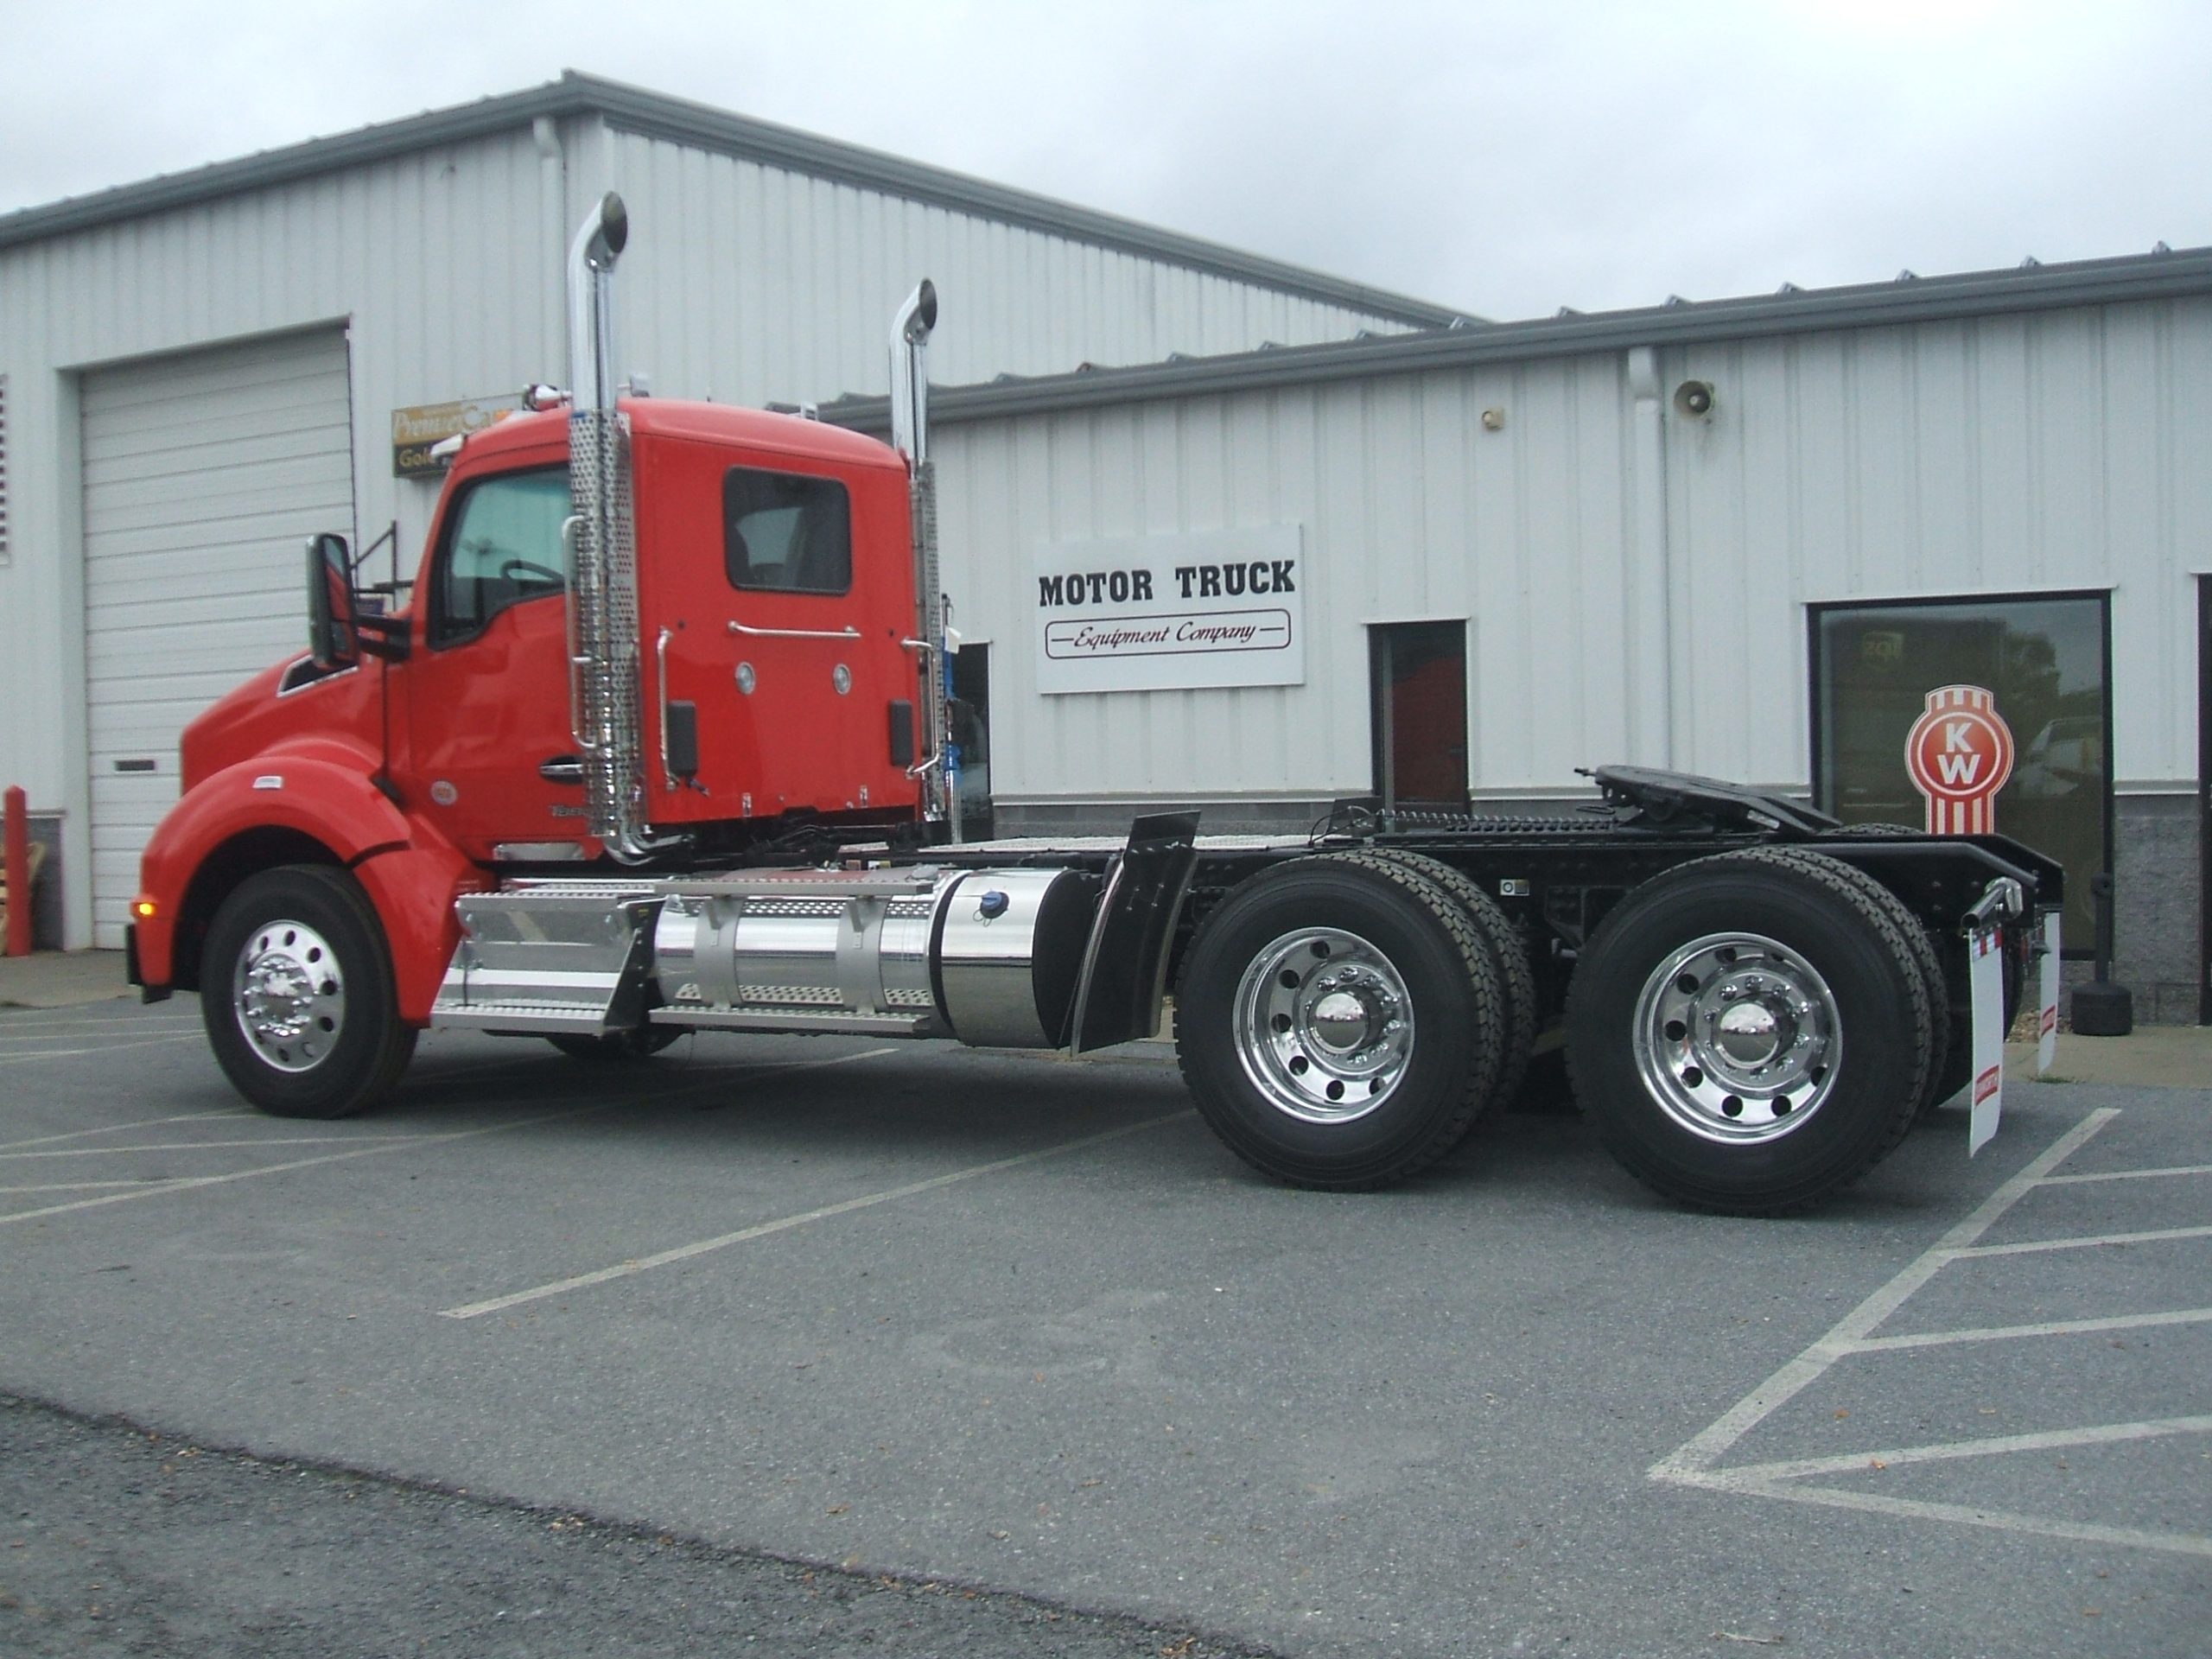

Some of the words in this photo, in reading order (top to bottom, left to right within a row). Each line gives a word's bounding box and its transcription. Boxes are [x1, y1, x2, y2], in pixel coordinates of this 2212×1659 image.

[1039, 569, 1154, 607] MOTOR
[1175, 560, 1295, 598] TRUCK
[1074, 626, 1170, 650] Equipment
[1176, 621, 1256, 644] Company
